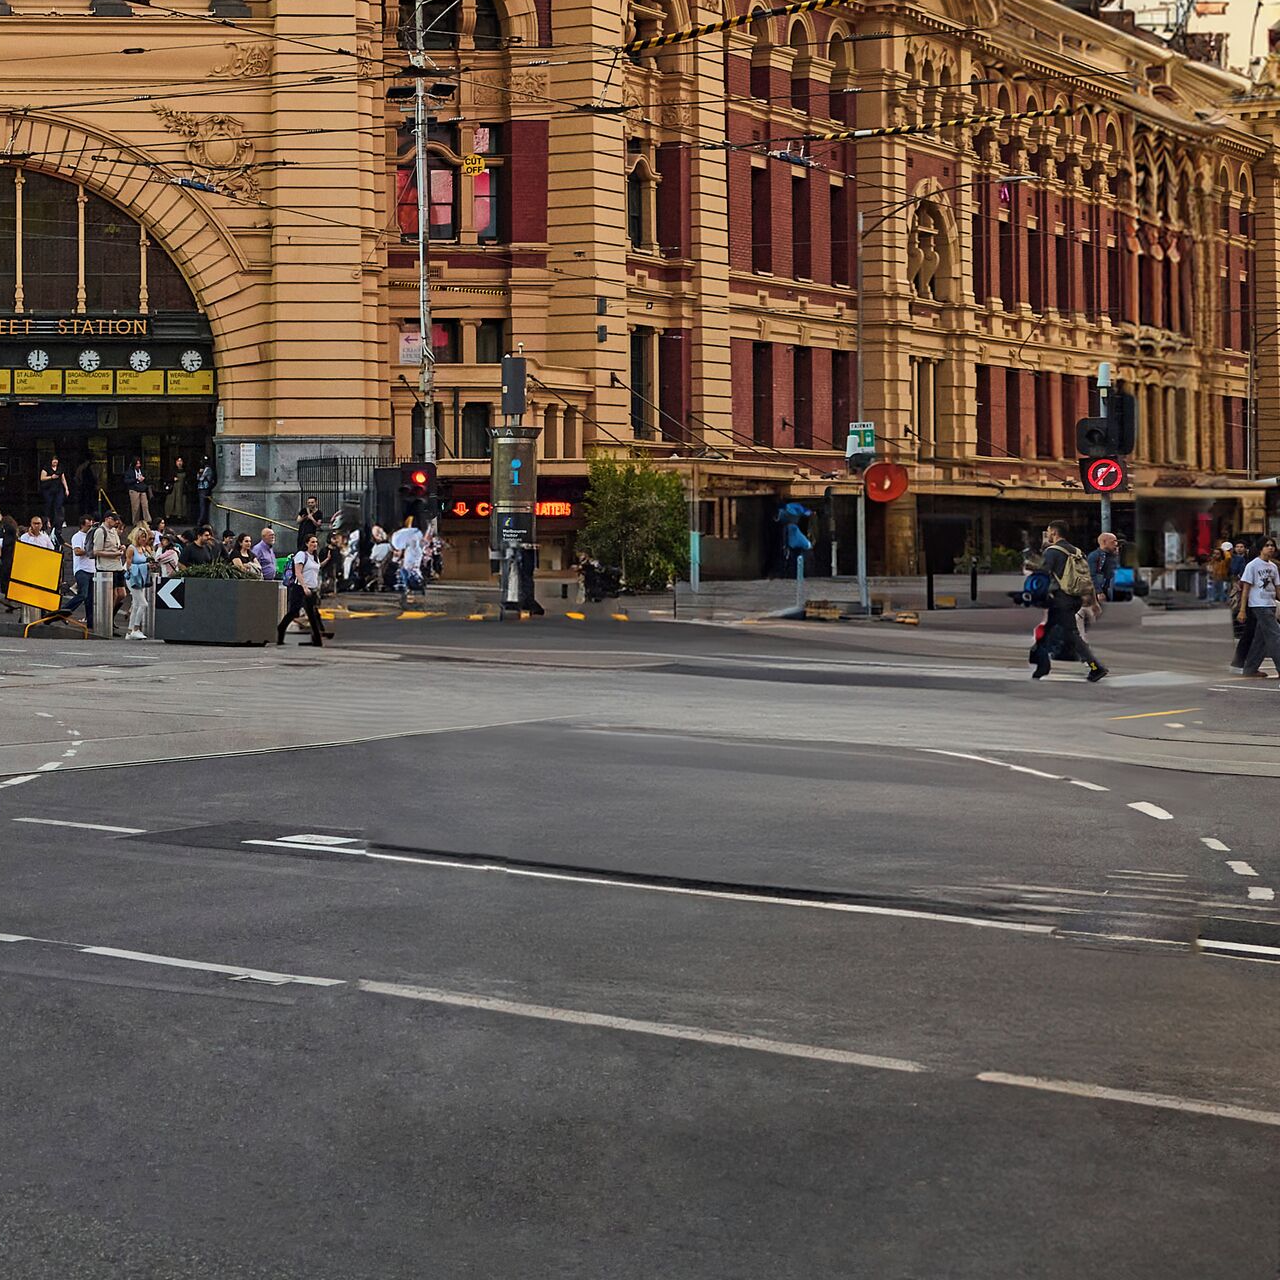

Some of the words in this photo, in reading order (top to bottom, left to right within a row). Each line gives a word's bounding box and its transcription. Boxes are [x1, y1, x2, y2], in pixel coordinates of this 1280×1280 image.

[465, 157, 482, 166] CUT
[466, 166, 483, 174] OFF
[58, 319, 147, 335] STATION
